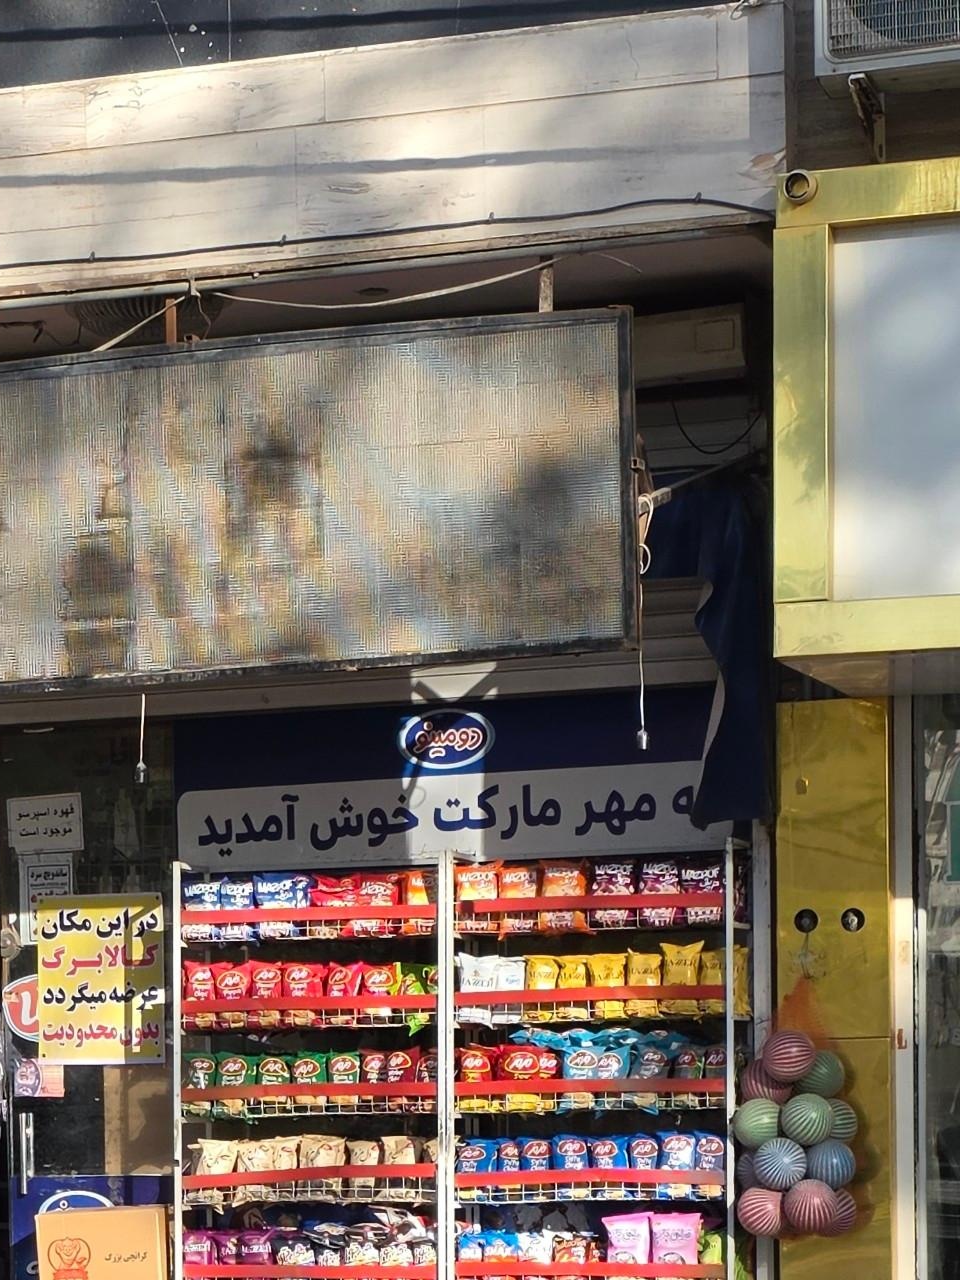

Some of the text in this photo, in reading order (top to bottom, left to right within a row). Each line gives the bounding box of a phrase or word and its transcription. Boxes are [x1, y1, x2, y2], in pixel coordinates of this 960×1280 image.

[414, 720, 485, 757] دومینو
[16, 806, 75, 822] قهوه اسپرسو
[198, 794, 298, 857] آمدید
[309, 796, 419, 850] خوش
[432, 784, 562, 840] مارکت
[575, 789, 657, 836] مهر
[19, 825, 73, 838] موجود است
[43, 868, 68, 881] ساندویچ
[41, 907, 159, 940] در این مکان
[42, 943, 159, 977] کالابرگ
[109, 982, 159, 1011] عرضه
[42, 1019, 160, 1048] بدون محدودیت
